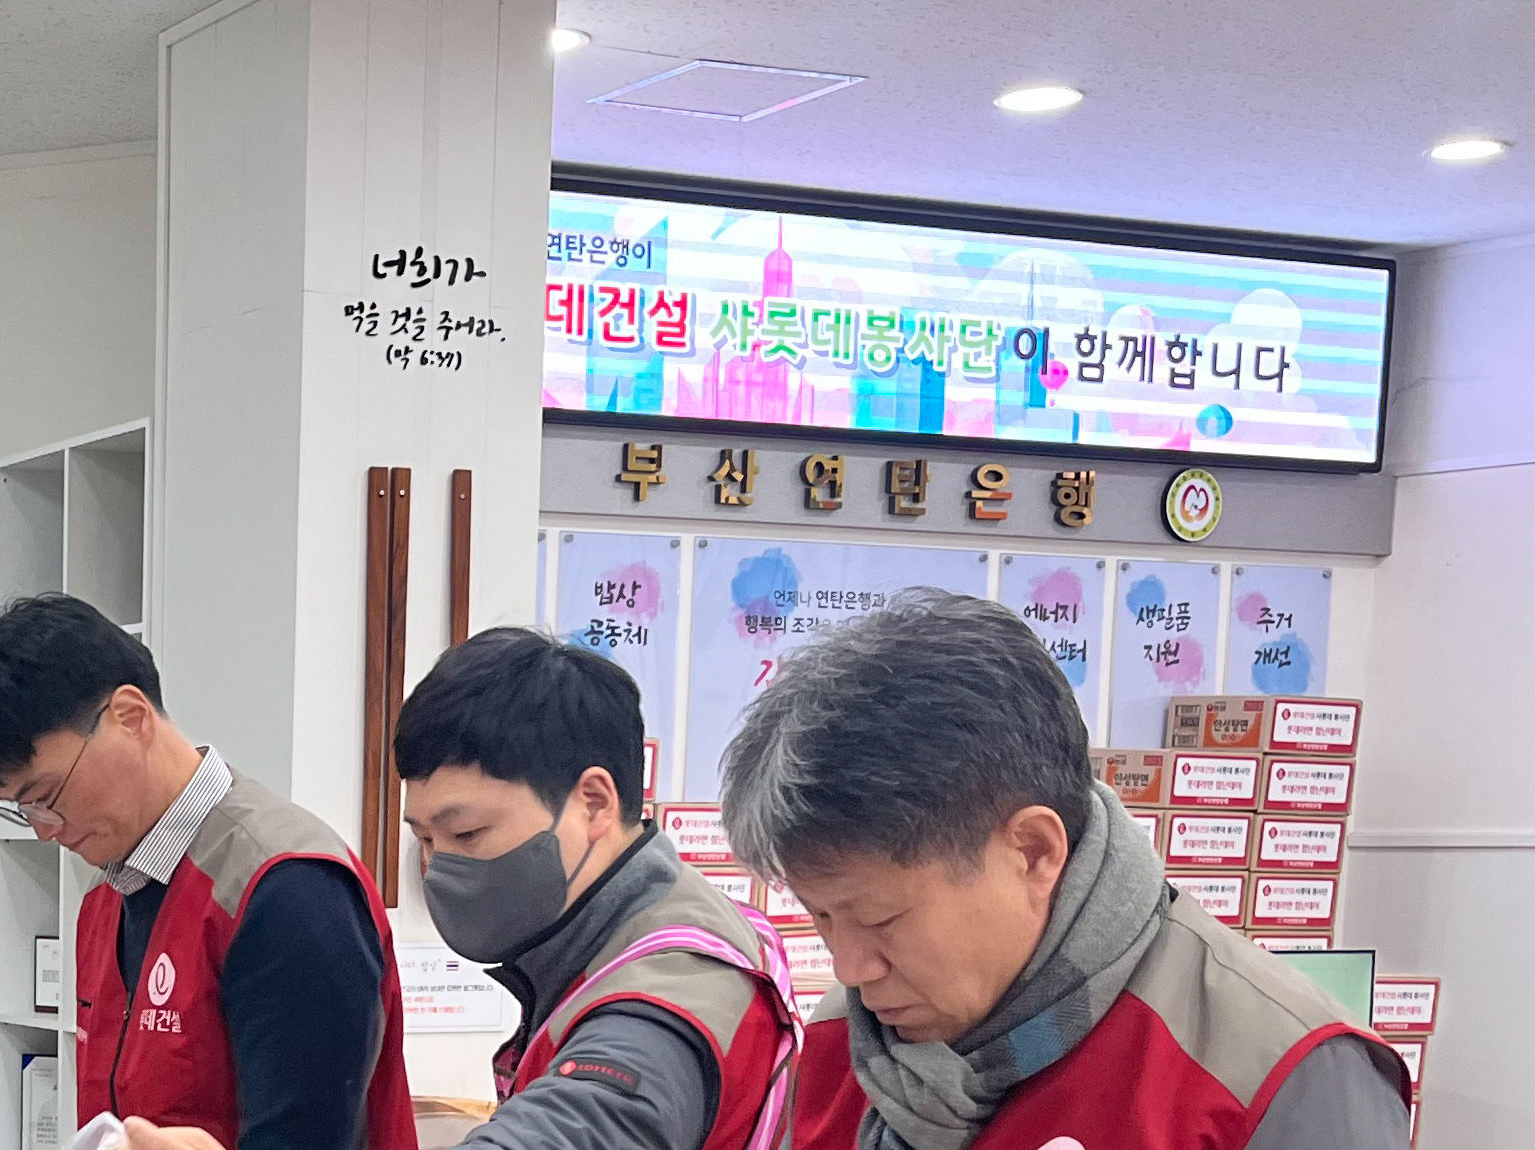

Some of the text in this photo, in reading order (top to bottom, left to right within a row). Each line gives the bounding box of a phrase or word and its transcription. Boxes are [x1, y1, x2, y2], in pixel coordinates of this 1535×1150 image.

[372, 246, 487, 288] 너희가
[344, 301, 380, 336] 먹을
[390, 306, 426, 341] 것을
[1074, 328, 1292, 394] 함께합니다
[595, 580, 641, 608] 밥상
[774, 590, 886, 611] 언제나 연탄은행과
[745, 614, 786, 634] 행복의
[1024, 602, 1077, 624] 에너지
[1135, 602, 1191, 631] 생필품
[1257, 606, 1292, 630] 주거
[584, 619, 648, 648] 공동체
[1043, 637, 1087, 662] 센터
[1143, 642, 1180, 667] 지원
[1255, 646, 1291, 669] 개선
[1214, 719, 1249, 732] 안성탕면
[1114, 773, 1149, 787] 안성탕면
